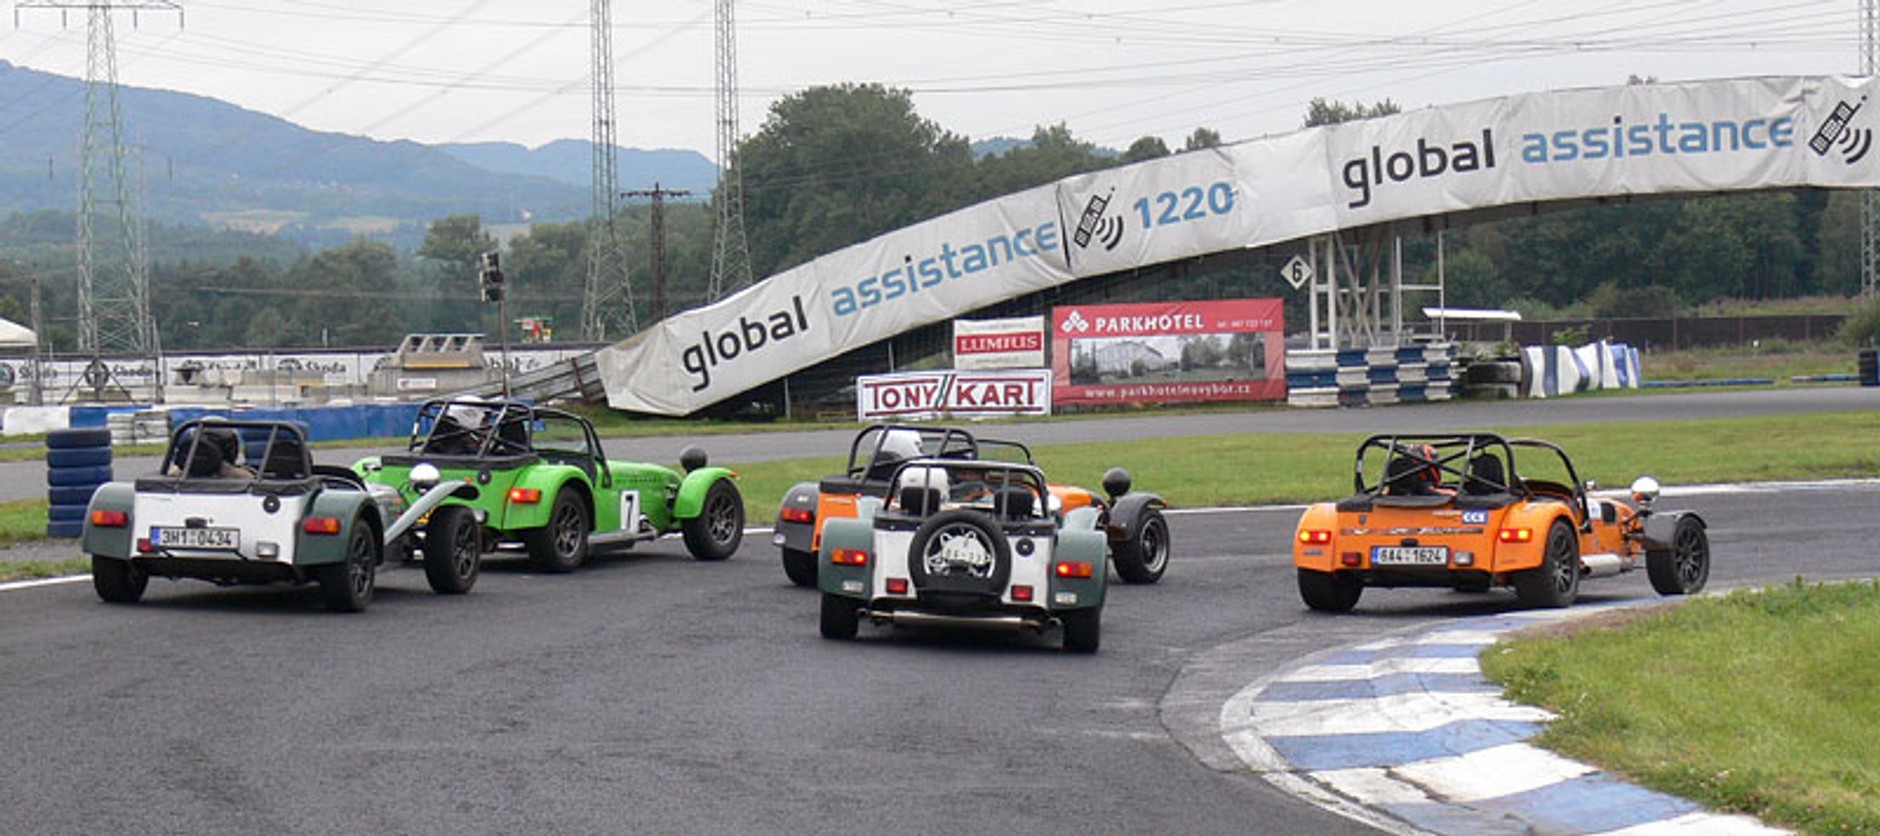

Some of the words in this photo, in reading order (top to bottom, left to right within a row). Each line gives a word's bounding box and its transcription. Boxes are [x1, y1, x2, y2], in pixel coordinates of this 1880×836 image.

[1343, 129, 1495, 209] global
[1522, 113, 1794, 163] assistance
[1292, 260, 1303, 283] 6
[682, 296, 808, 393] global
[831, 221, 1058, 316] assistance
[1133, 181, 1234, 229] 1220
[1095, 314, 1205, 332] PARKHOTEL
[961, 335, 1038, 352] LUMIUS
[864, 379, 939, 410] TONY
[956, 378, 1045, 406] KART
[626, 494, 634, 534] 7
[162, 530, 188, 544] 3H1
